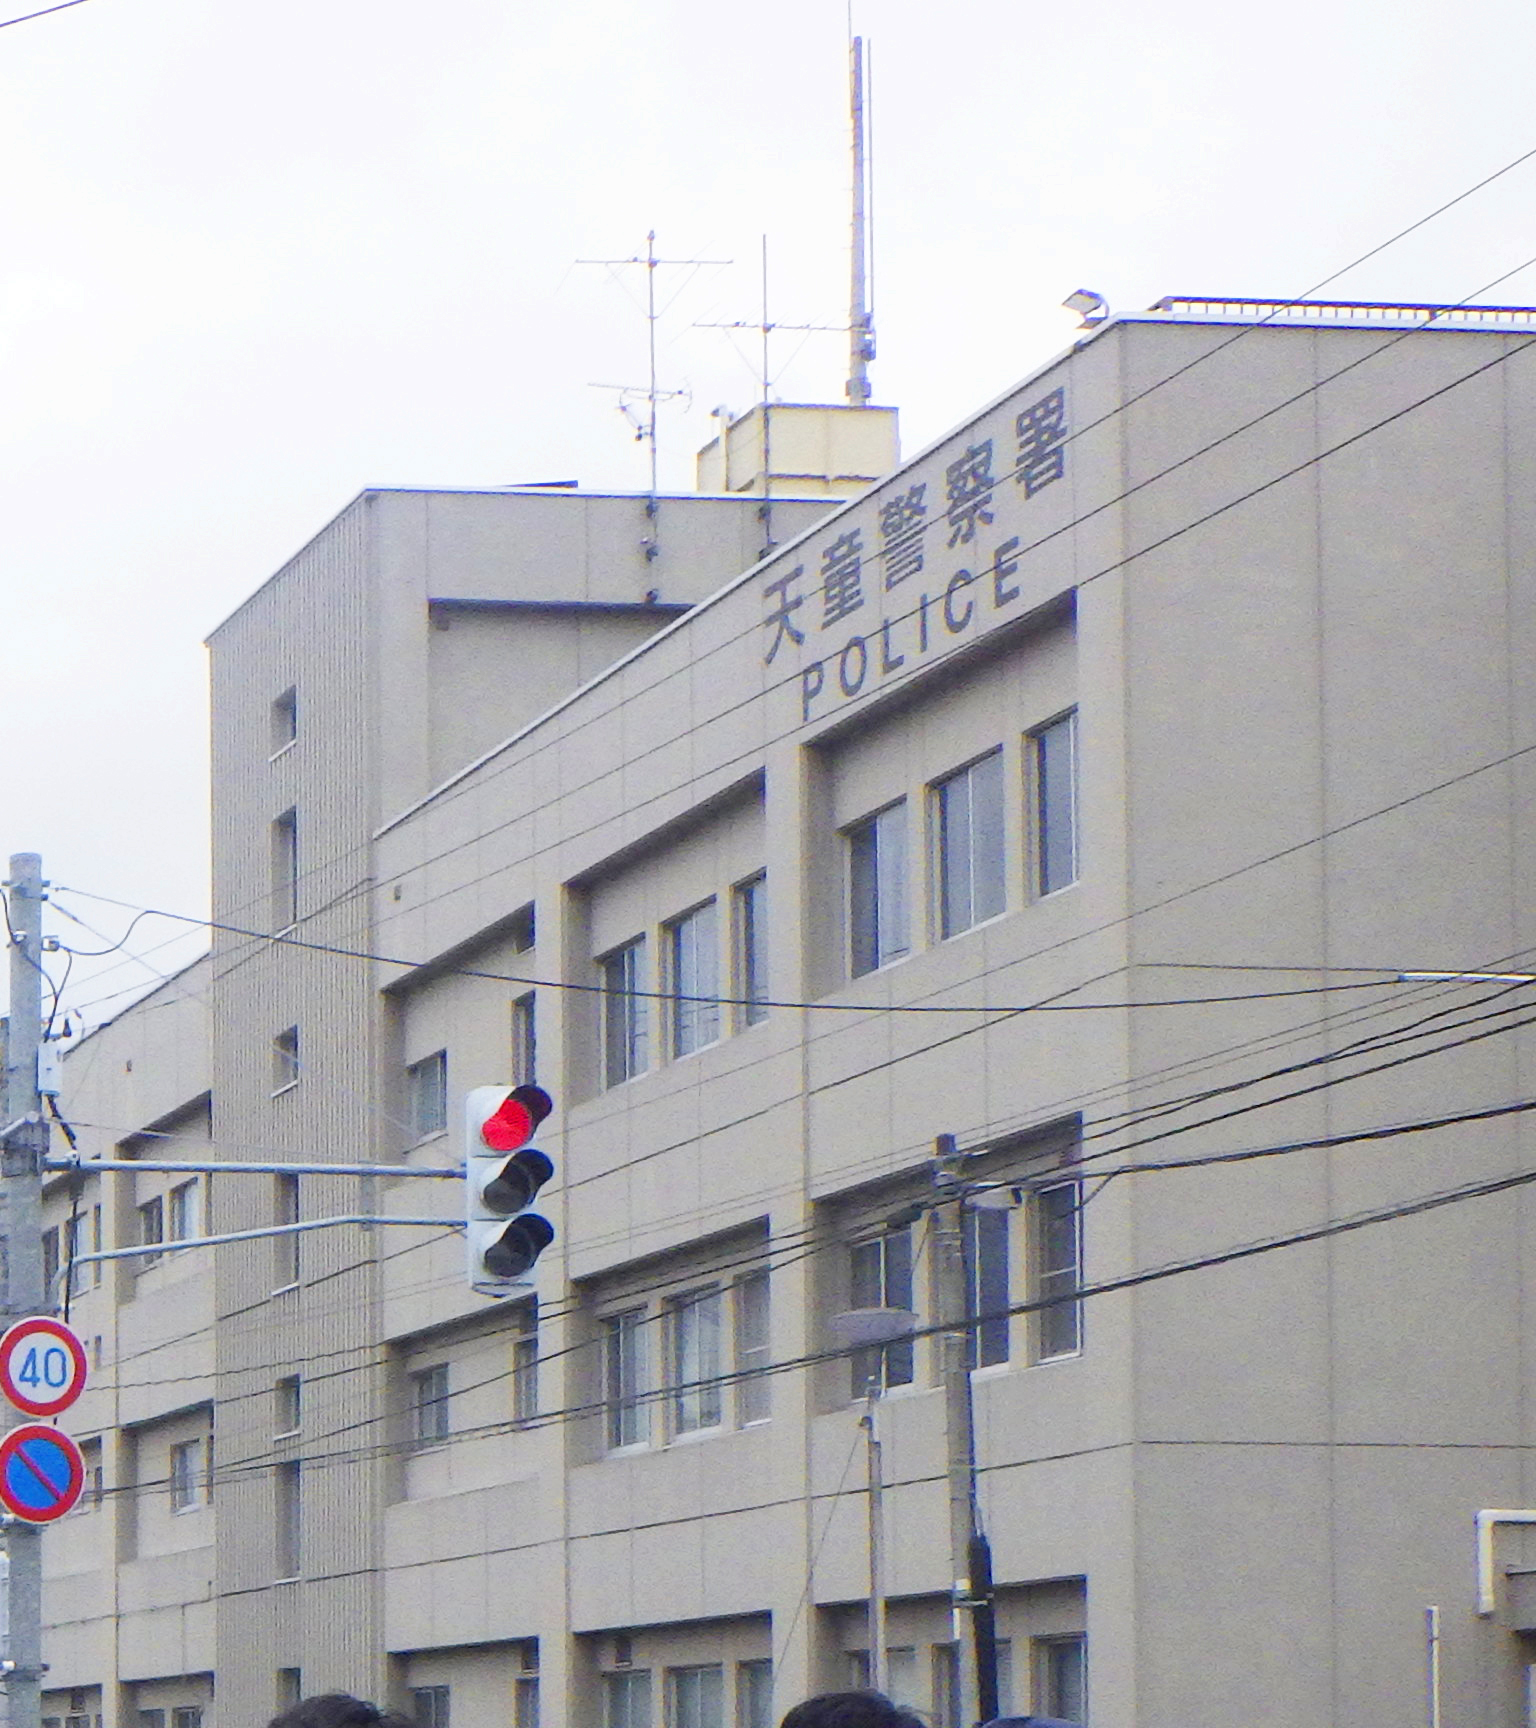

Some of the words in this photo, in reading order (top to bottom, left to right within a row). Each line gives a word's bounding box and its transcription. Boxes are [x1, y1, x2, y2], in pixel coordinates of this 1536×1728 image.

[762, 386, 1068, 666] 天童警察署
[802, 536, 1020, 722] POLICE
[18, 1346, 67, 1388] 40
